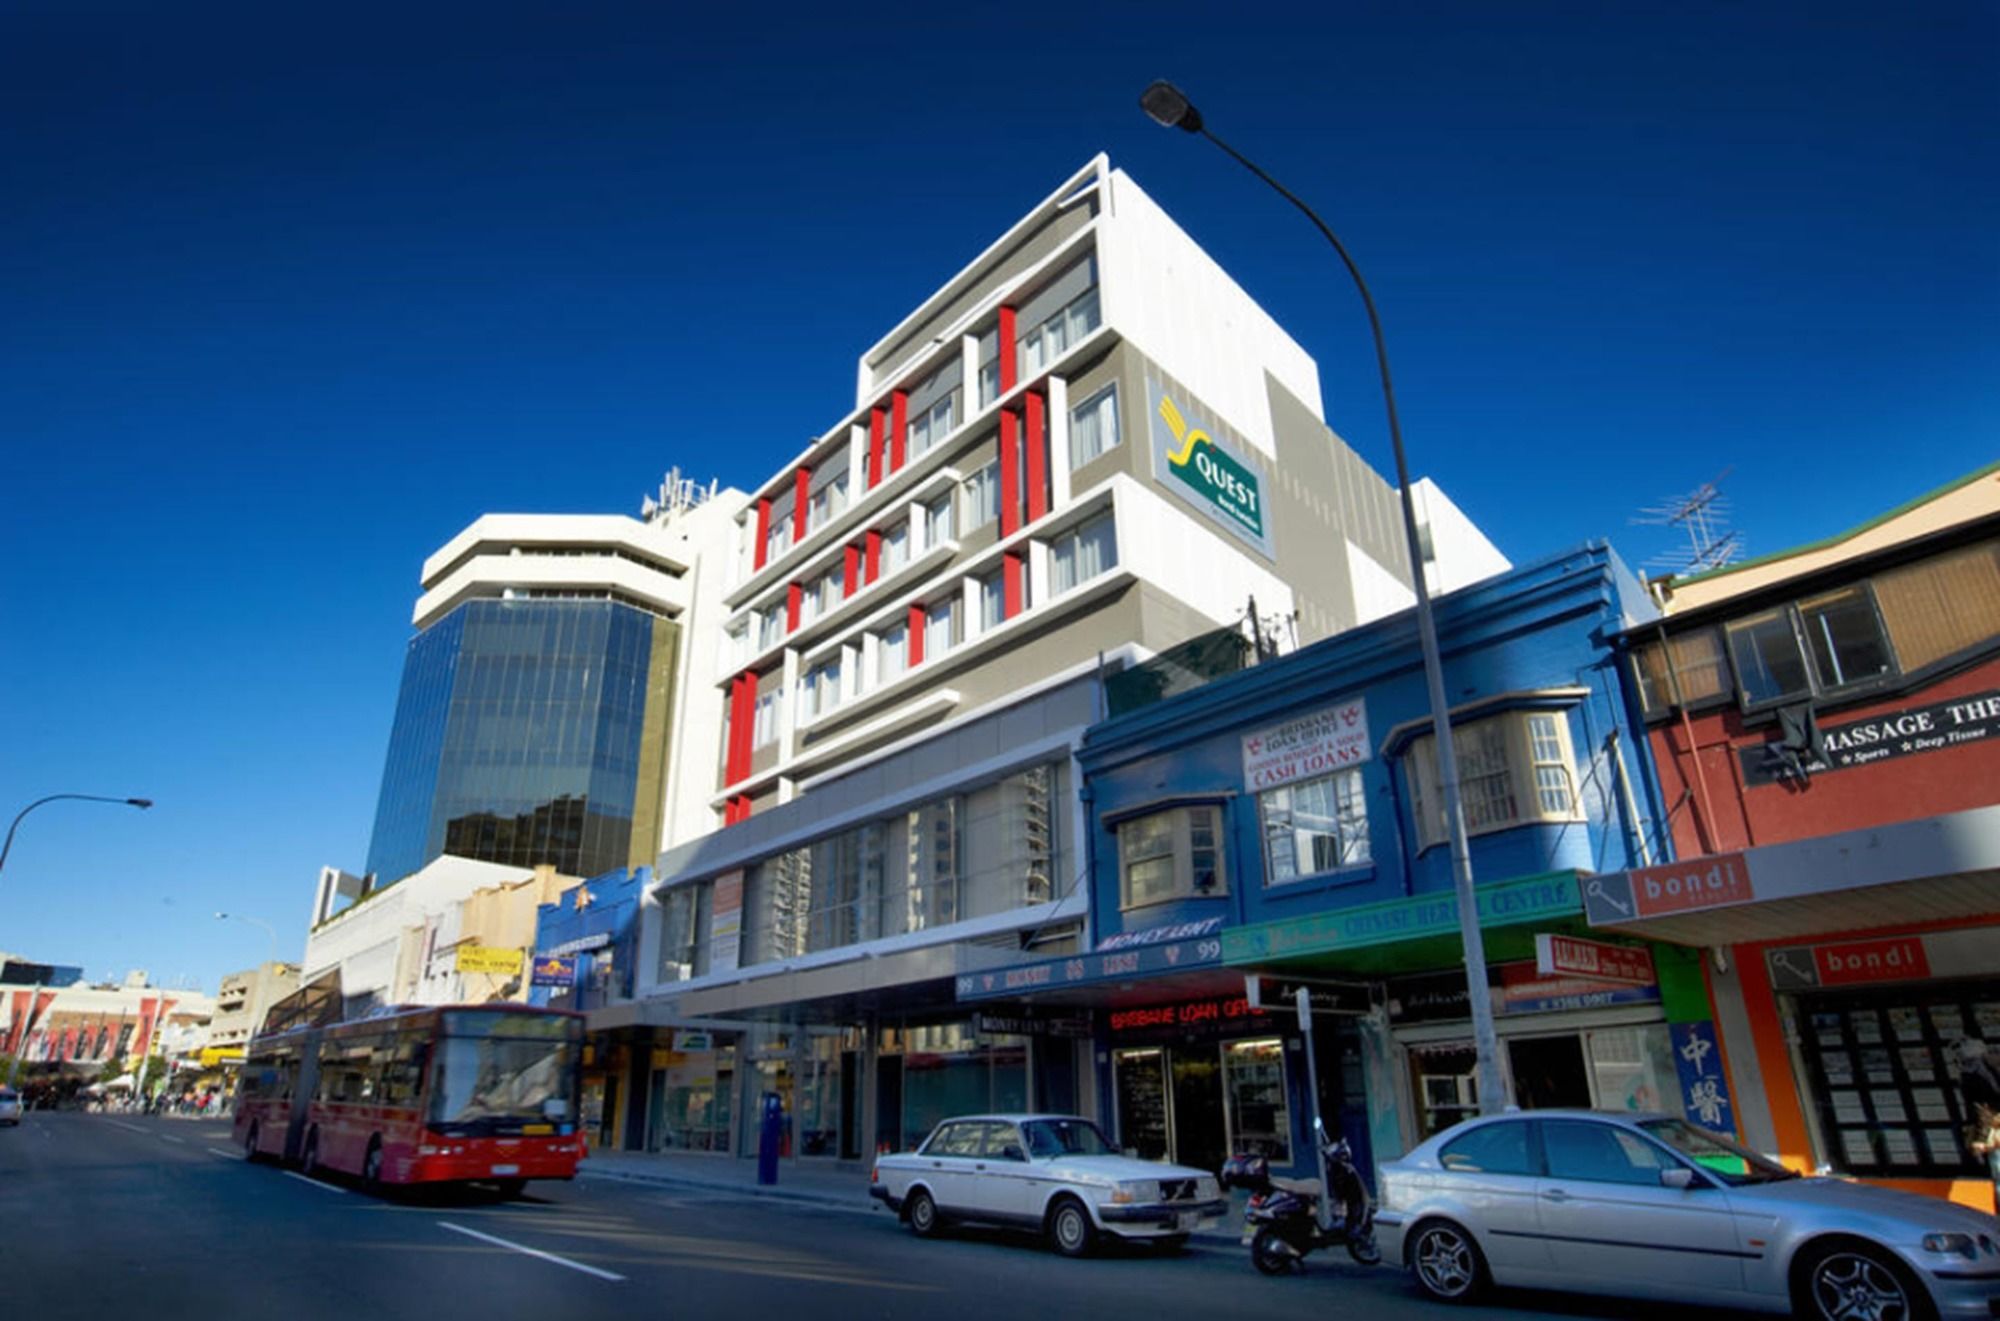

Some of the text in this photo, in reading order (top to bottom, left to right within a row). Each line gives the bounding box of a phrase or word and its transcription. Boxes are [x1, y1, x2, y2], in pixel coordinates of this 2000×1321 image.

[1195, 452, 1256, 512] QUEST
[1266, 734, 1297, 752] LOAN
[1823, 712, 1934, 752] MASSAGE
[1854, 728, 1987, 764] Sports Deep Tissue
[1253, 764, 1297, 787] CASH
[1303, 745, 1361, 773] LOANS
[1491, 881, 1568, 915] CENTRE
[1644, 863, 1737, 899] bondi
[957, 977, 974, 993] 99
[1197, 940, 1220, 960] 99
[1826, 944, 1914, 972] bondi
[1179, 1001, 1219, 1023] LOAN
[1679, 1033, 1728, 1125] 中醫
